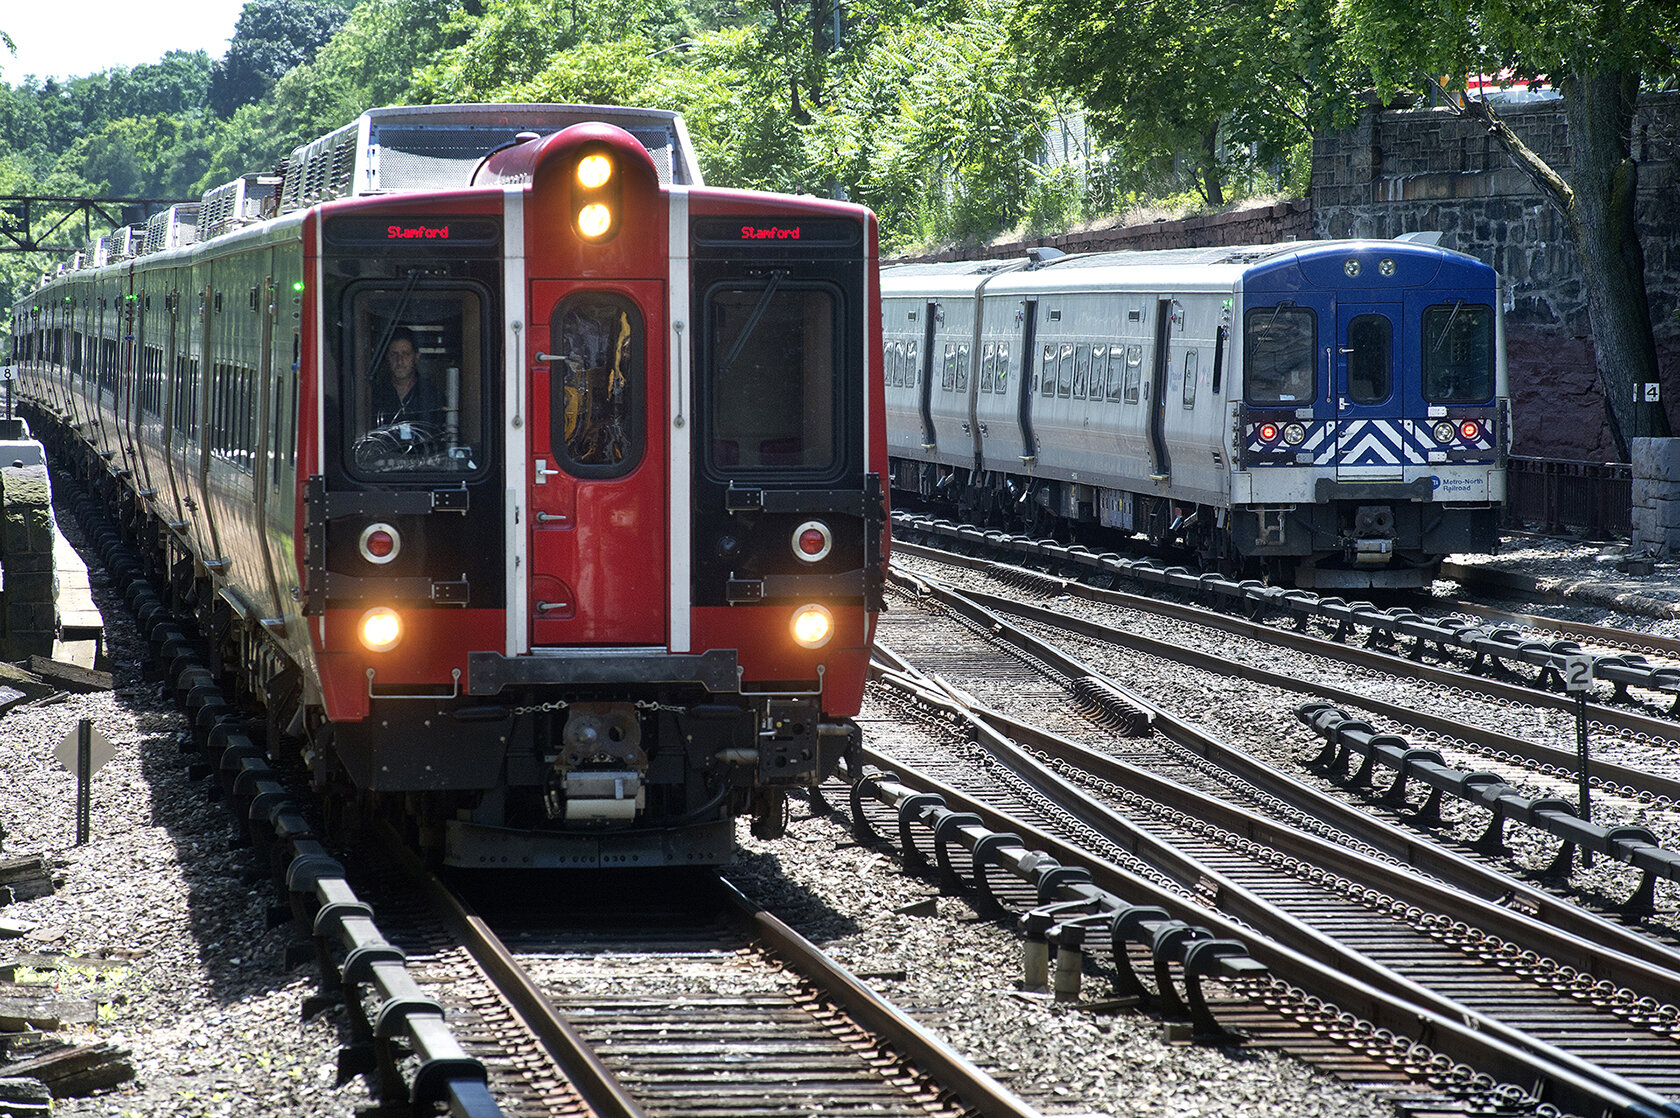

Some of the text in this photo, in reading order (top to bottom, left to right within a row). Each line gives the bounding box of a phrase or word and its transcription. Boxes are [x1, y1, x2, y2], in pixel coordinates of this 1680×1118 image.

[387, 225, 449, 239] Stamford
[741, 226, 800, 239] Stamford
[4, 368, 11, 378] 8
[1646, 386, 1658, 398] 4
[1570, 661, 1588, 684] 2
